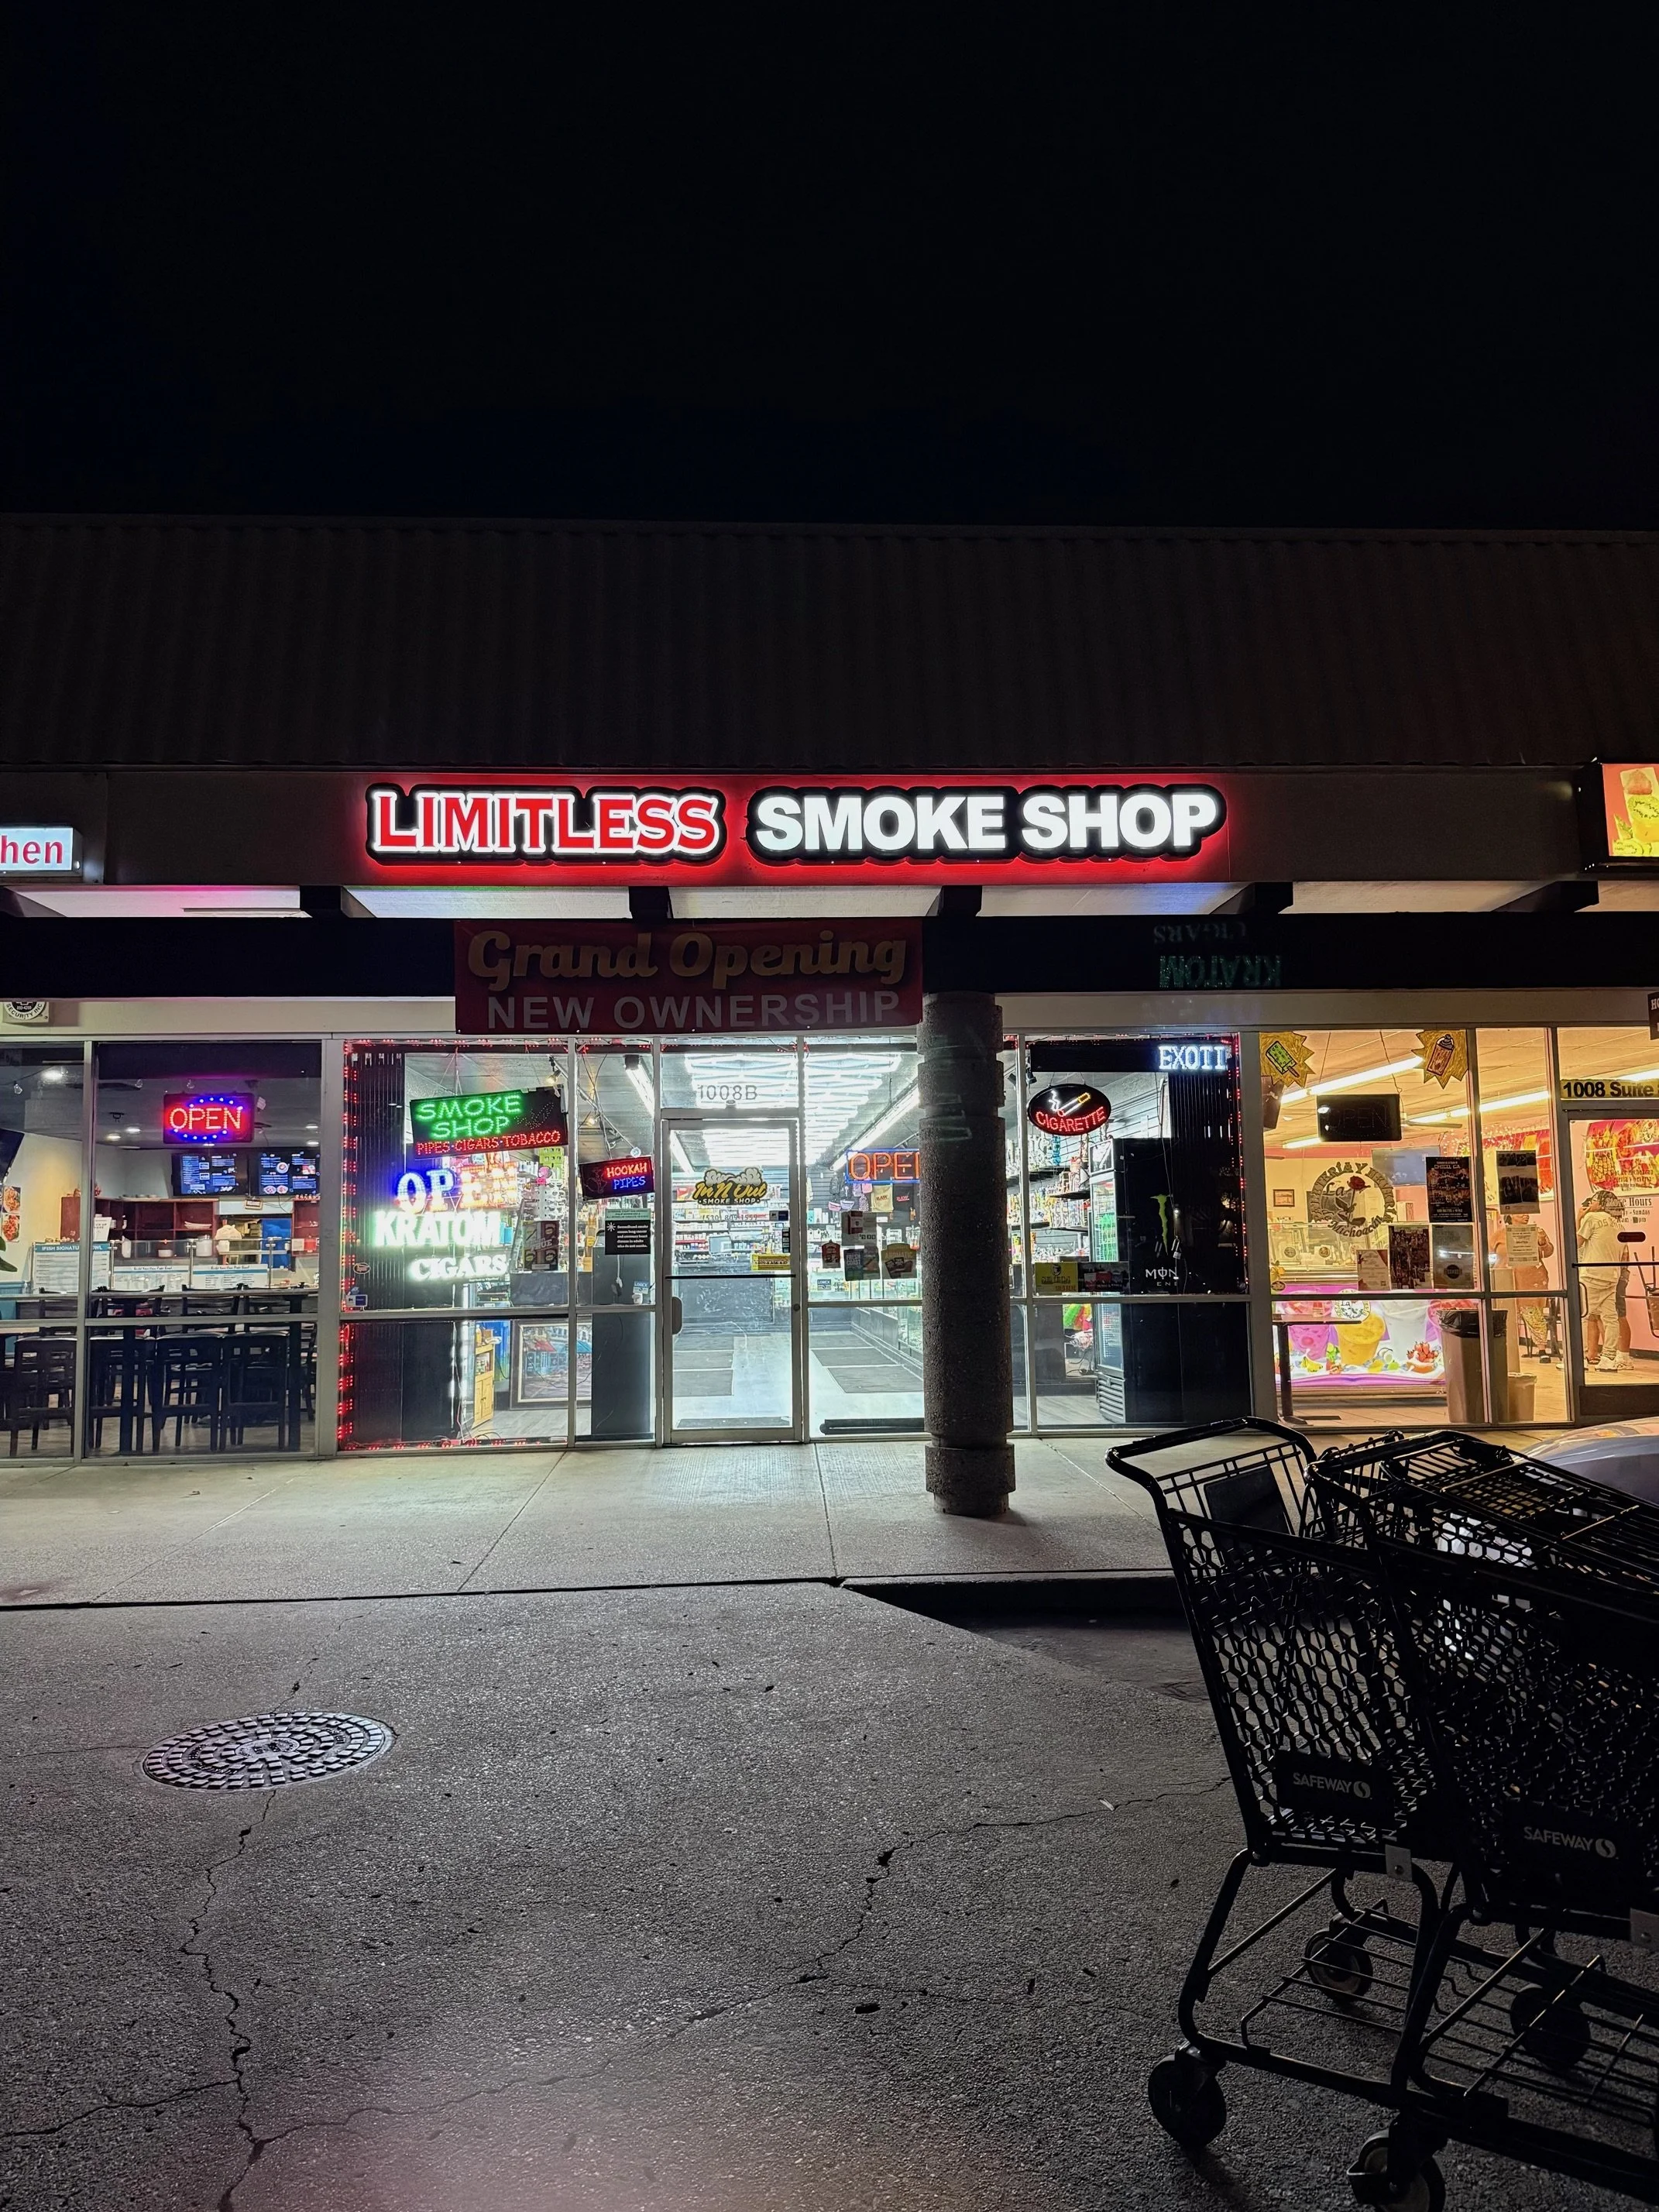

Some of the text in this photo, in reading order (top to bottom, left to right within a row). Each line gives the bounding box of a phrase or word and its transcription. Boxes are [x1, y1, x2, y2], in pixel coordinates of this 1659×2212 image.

[375, 792, 1218, 853] LIMITLESS SMOKE SHOP
[0, 835, 63, 864] hen
[467, 930, 907, 991] Grand Opening
[6, 1003, 43, 1019] SECURITY INC
[487, 990, 902, 1029] NEW OWNERSHIP
[1159, 1046, 1226, 1070] EXOTI
[698, 1084, 758, 1101] 1008B
[1563, 1081, 1654, 1097] 1008 Suite
[170, 1108, 242, 1130] OPEN
[416, 1095, 522, 1120] SMOKE
[1035, 1106, 1105, 1132] CIGARETTE
[431, 1115, 510, 1139] SHOP
[502, 1130, 562, 1147] TOBACCO
[606, 1163, 648, 1178] HOOKAH
[613, 1175, 647, 1190] PIPES
[714, 1182, 733, 1199] N
[733, 1182, 767, 1199] Out
[1322, 1182, 1345, 1197] La
[1629, 1197, 1652, 1207] Hours
[376, 1211, 501, 1246] KRATOM
[410, 1254, 508, 1280] CIGARS
[1293, 1772, 1353, 1794] SAFEWAY
[1523, 1826, 1595, 1852] SAFEWAY
